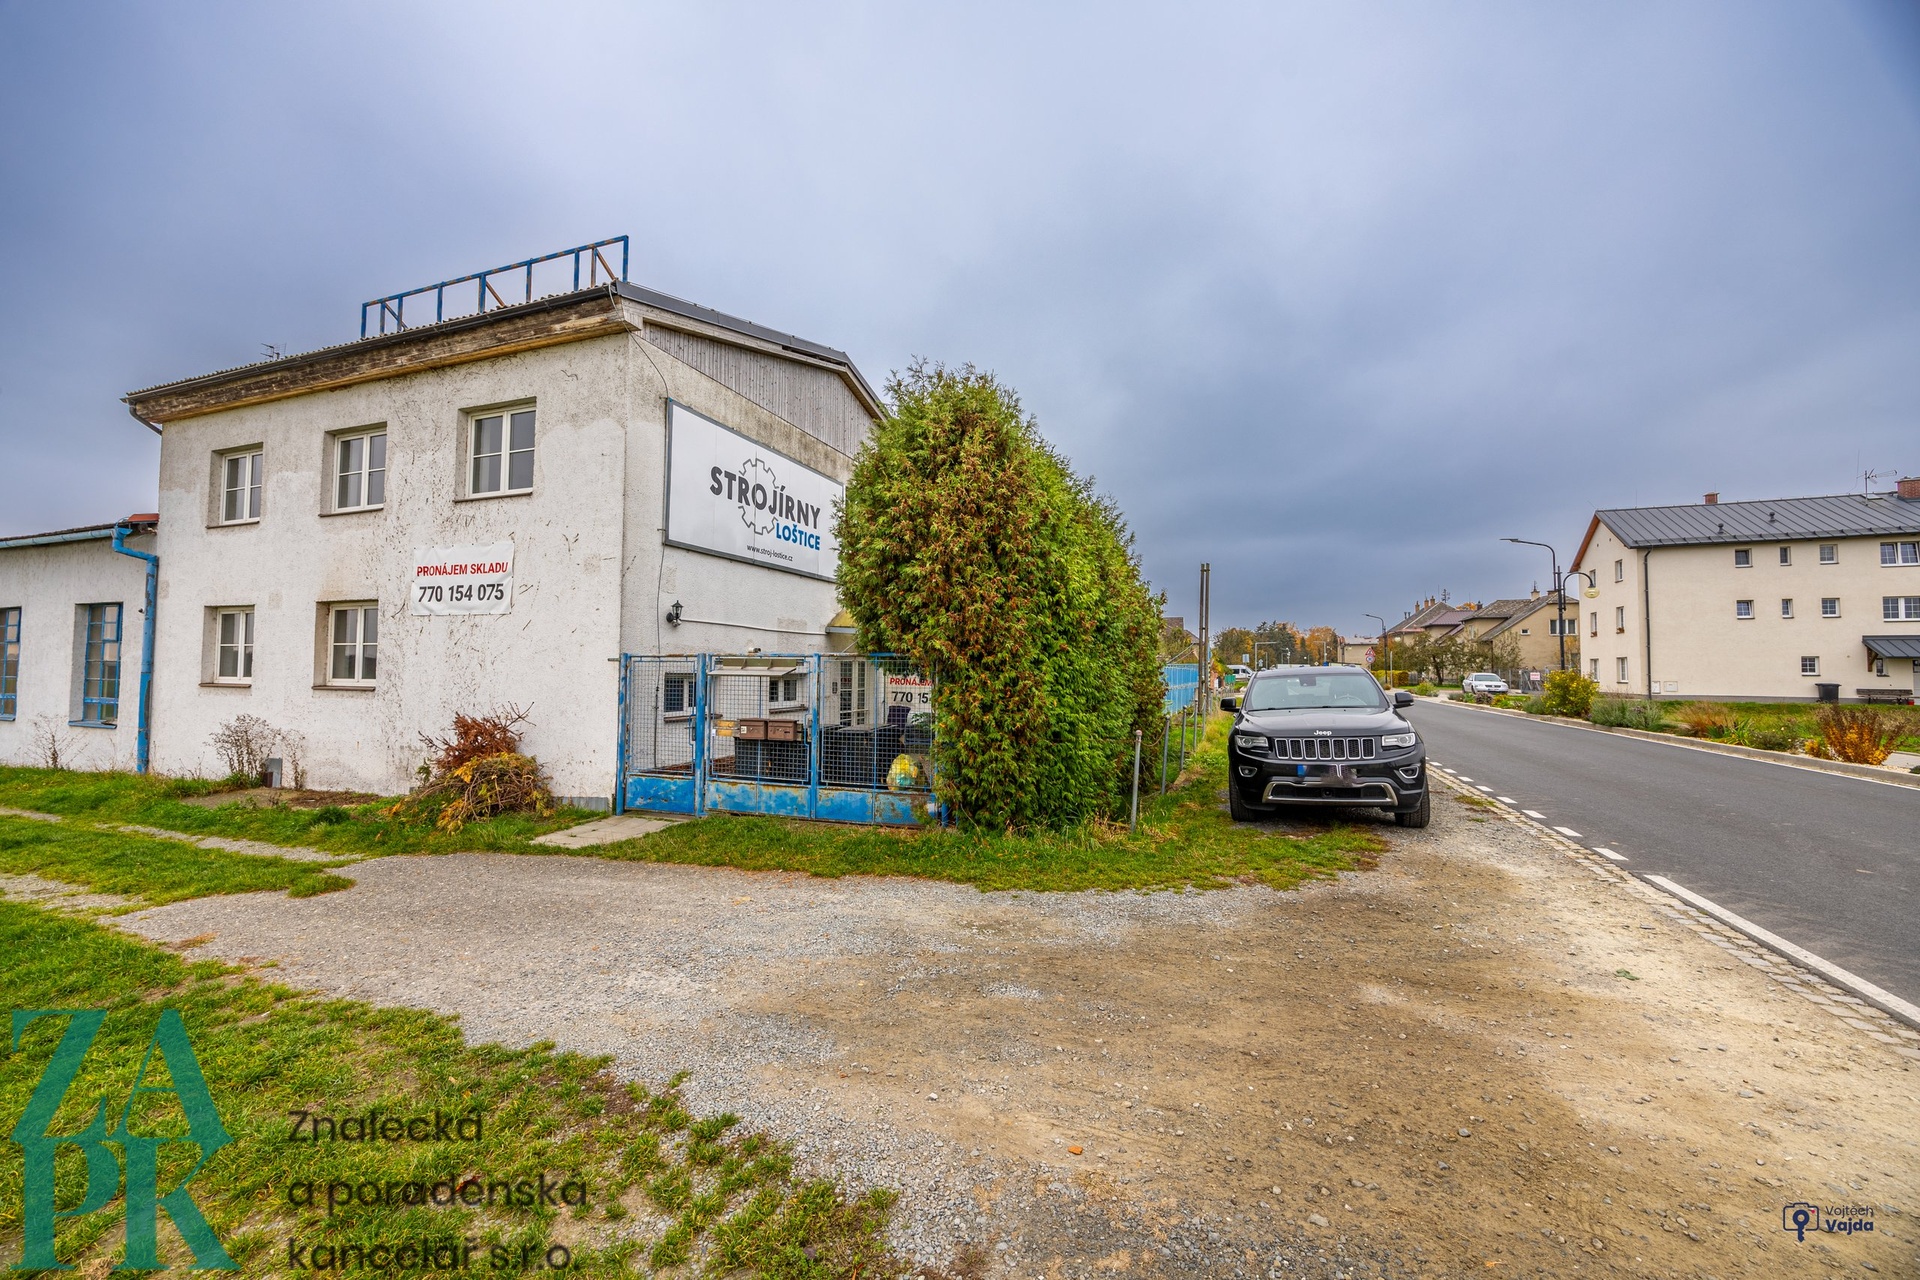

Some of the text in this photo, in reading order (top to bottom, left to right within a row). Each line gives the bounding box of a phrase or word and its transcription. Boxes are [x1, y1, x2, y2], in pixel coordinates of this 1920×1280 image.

[709, 466, 821, 529] STROJÍRNY
[776, 522, 821, 551] LOŠTICE
[746, 544, 794, 562] www.stroj-lostice.cz
[416, 561, 508, 577] PRONÁJEM SKLADU
[418, 583, 504, 602] 770 154 075
[891, 691, 914, 703] 770
[1313, 729, 1333, 737] Jeep
